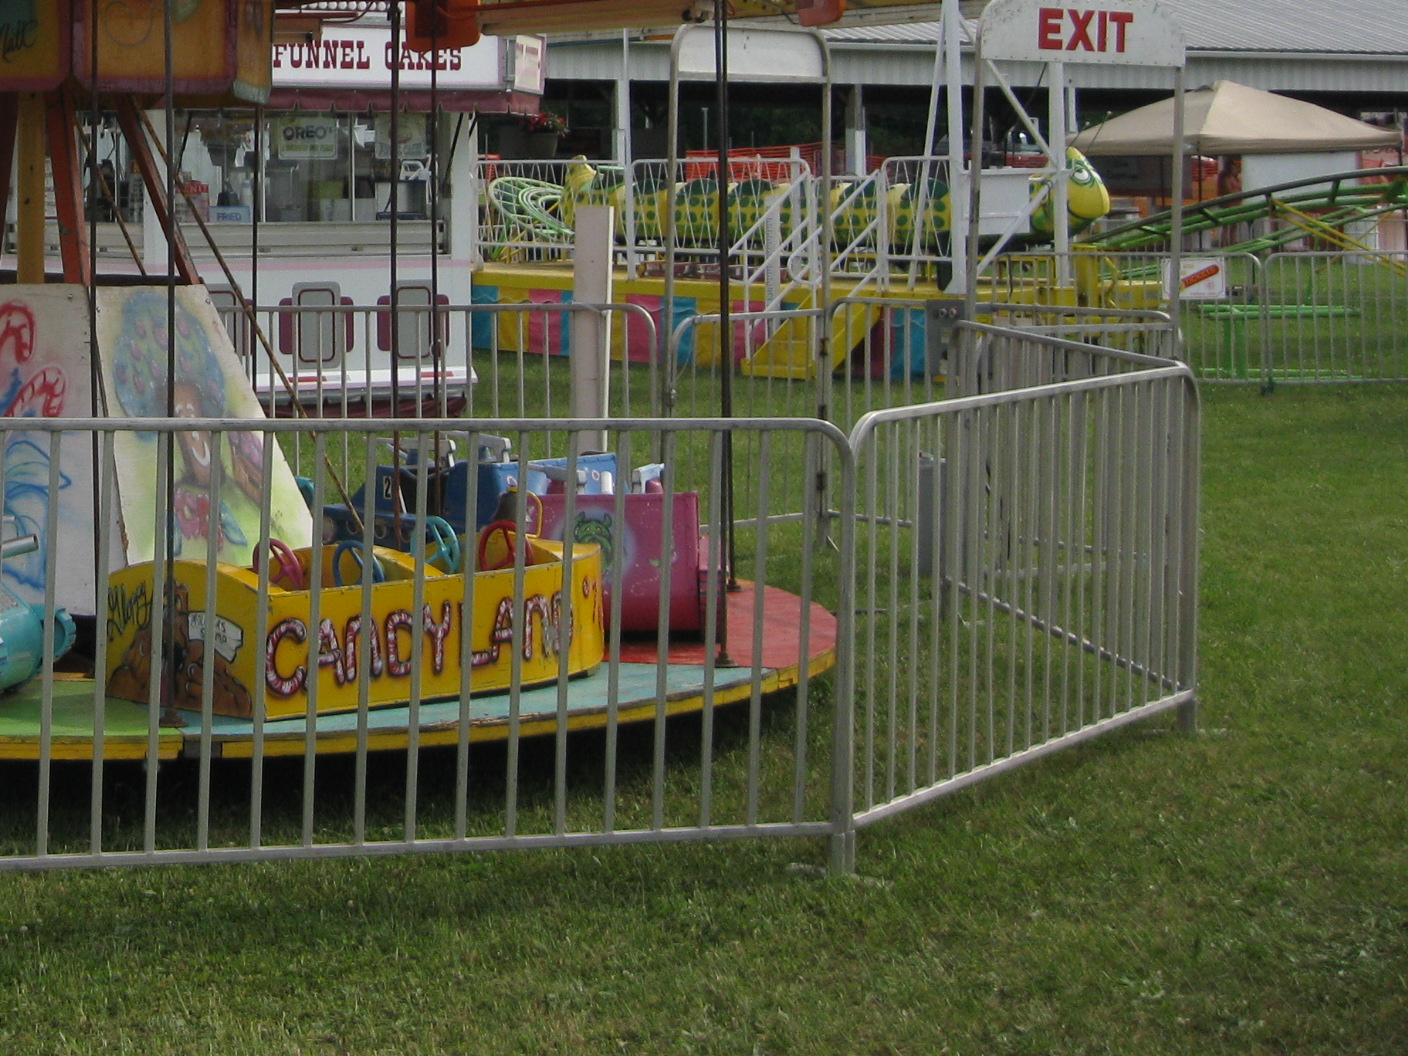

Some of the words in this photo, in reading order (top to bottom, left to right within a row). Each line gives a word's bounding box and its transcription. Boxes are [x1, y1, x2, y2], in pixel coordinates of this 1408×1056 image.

[1038, 7, 1134, 53] EXIT
[273, 40, 371, 70] FUNNEL
[384, 476, 391, 498] 2
